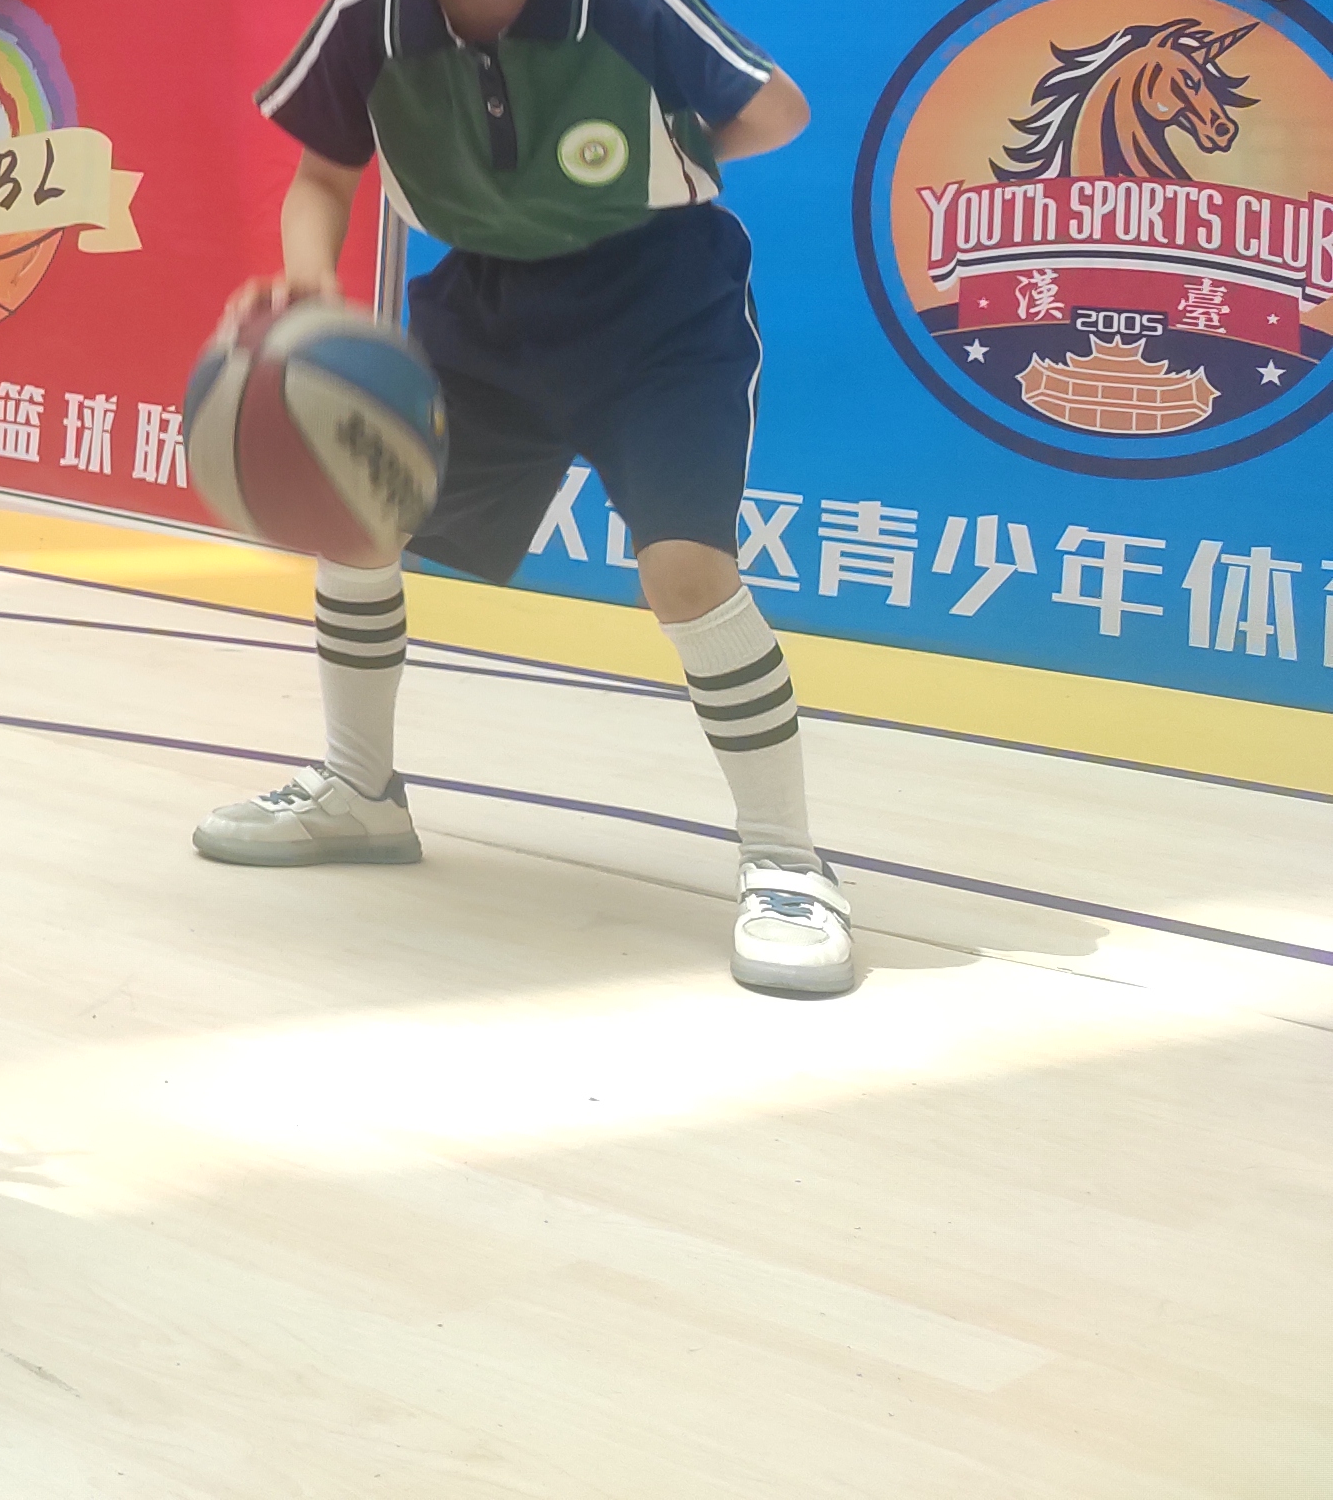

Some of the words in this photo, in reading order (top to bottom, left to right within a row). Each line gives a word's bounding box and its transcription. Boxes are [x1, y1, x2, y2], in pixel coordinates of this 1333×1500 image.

[1069, 180, 1223, 250] SPORTS
[1015, 270, 1065, 320] 漢
[1075, 310, 1165, 336] 2005
[528, 465, 1333, 668] 区青少年体
